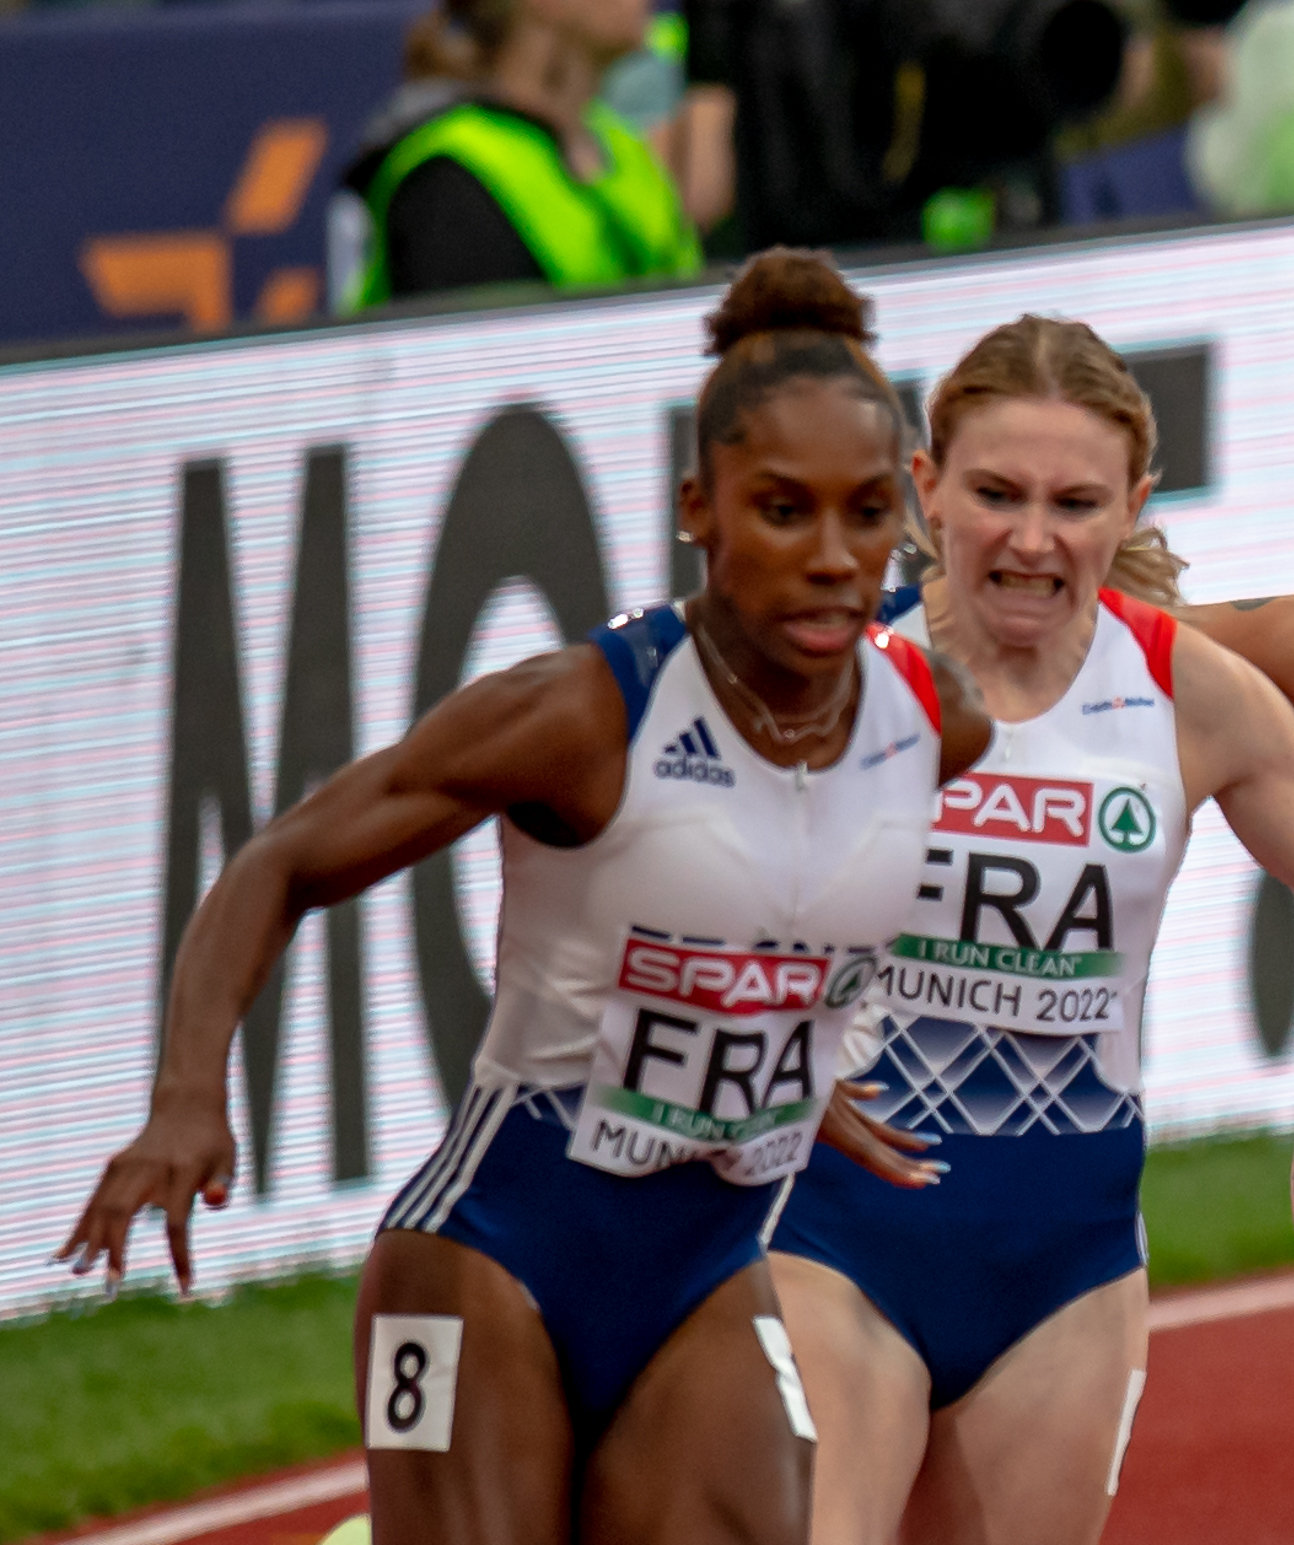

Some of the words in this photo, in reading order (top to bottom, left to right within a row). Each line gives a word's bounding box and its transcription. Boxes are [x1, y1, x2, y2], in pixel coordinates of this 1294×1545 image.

[654, 757, 735, 787] adidas
[930, 779, 1086, 837] PAR
[624, 947, 821, 1008] SPAR
[932, 942, 990, 967] RUN
[1036, 987, 1112, 1023] 2022
[623, 1007, 814, 1115] FRA
[386, 1341, 428, 1434] 8
